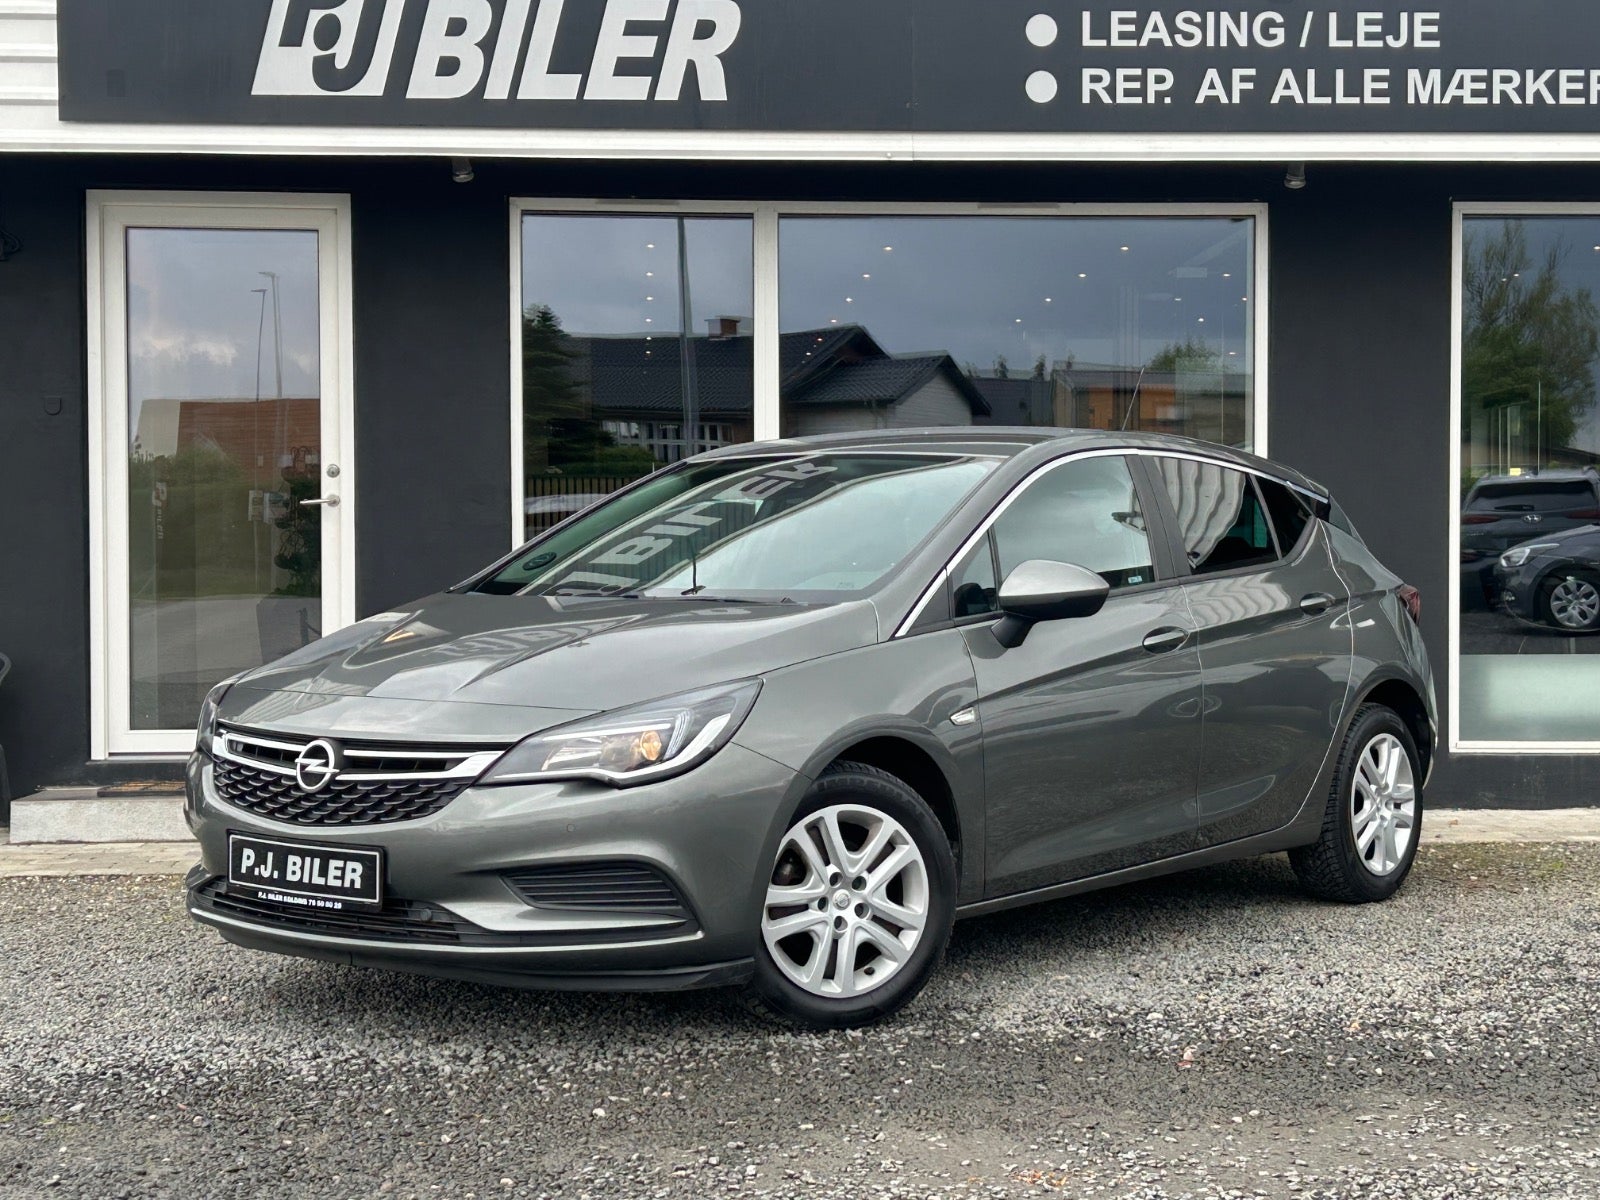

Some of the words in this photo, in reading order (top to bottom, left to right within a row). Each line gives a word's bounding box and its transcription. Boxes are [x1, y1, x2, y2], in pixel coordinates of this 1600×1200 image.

[1081, 10, 1285, 48] LEASING
[1299, 11, 1314, 47] /
[1328, 11, 1441, 48] LEJE
[406, 0, 741, 100] BILER
[1081, 68, 1172, 104] REP.
[1195, 68, 1257, 104] AF
[1270, 68, 1391, 104] ALLE
[240, 847, 278, 879] P.J.
[286, 854, 363, 889] BILER
